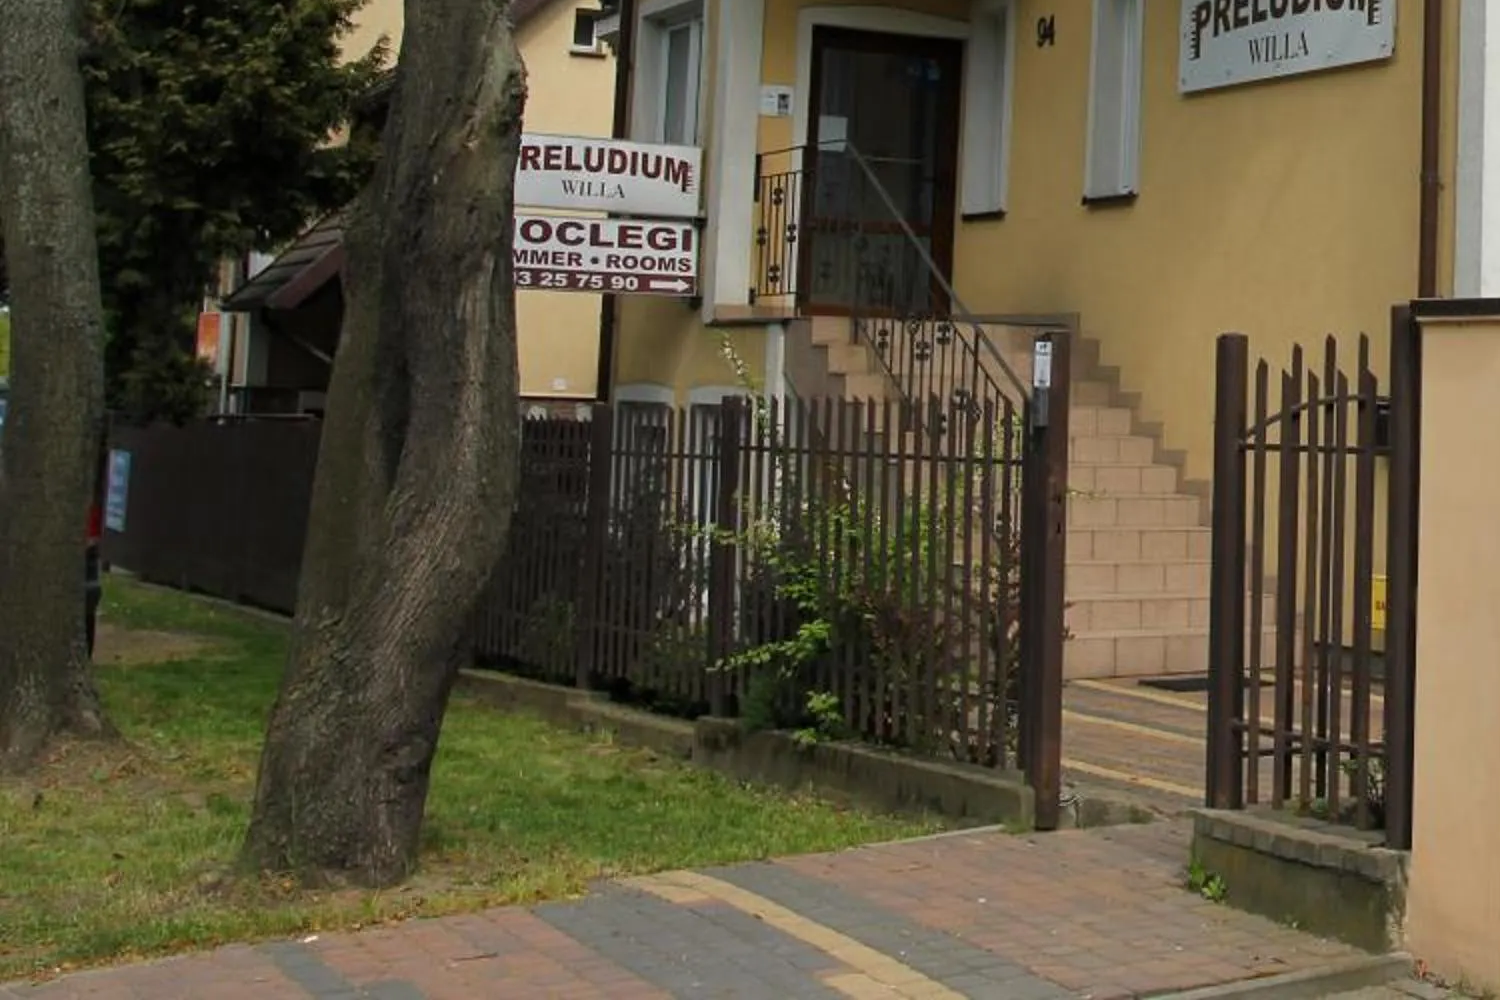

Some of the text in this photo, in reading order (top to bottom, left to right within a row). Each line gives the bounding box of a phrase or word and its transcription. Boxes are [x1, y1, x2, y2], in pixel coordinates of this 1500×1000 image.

[1037, 14, 1055, 48] 94
[1248, 31, 1309, 64] WILLA
[519, 145, 690, 192] RELUDIUM
[561, 179, 626, 199] WILLA
[513, 219, 692, 252] OCLEGI
[513, 249, 692, 273] MMER ROOMS
[513, 271, 639, 291] 3 25 75 90
